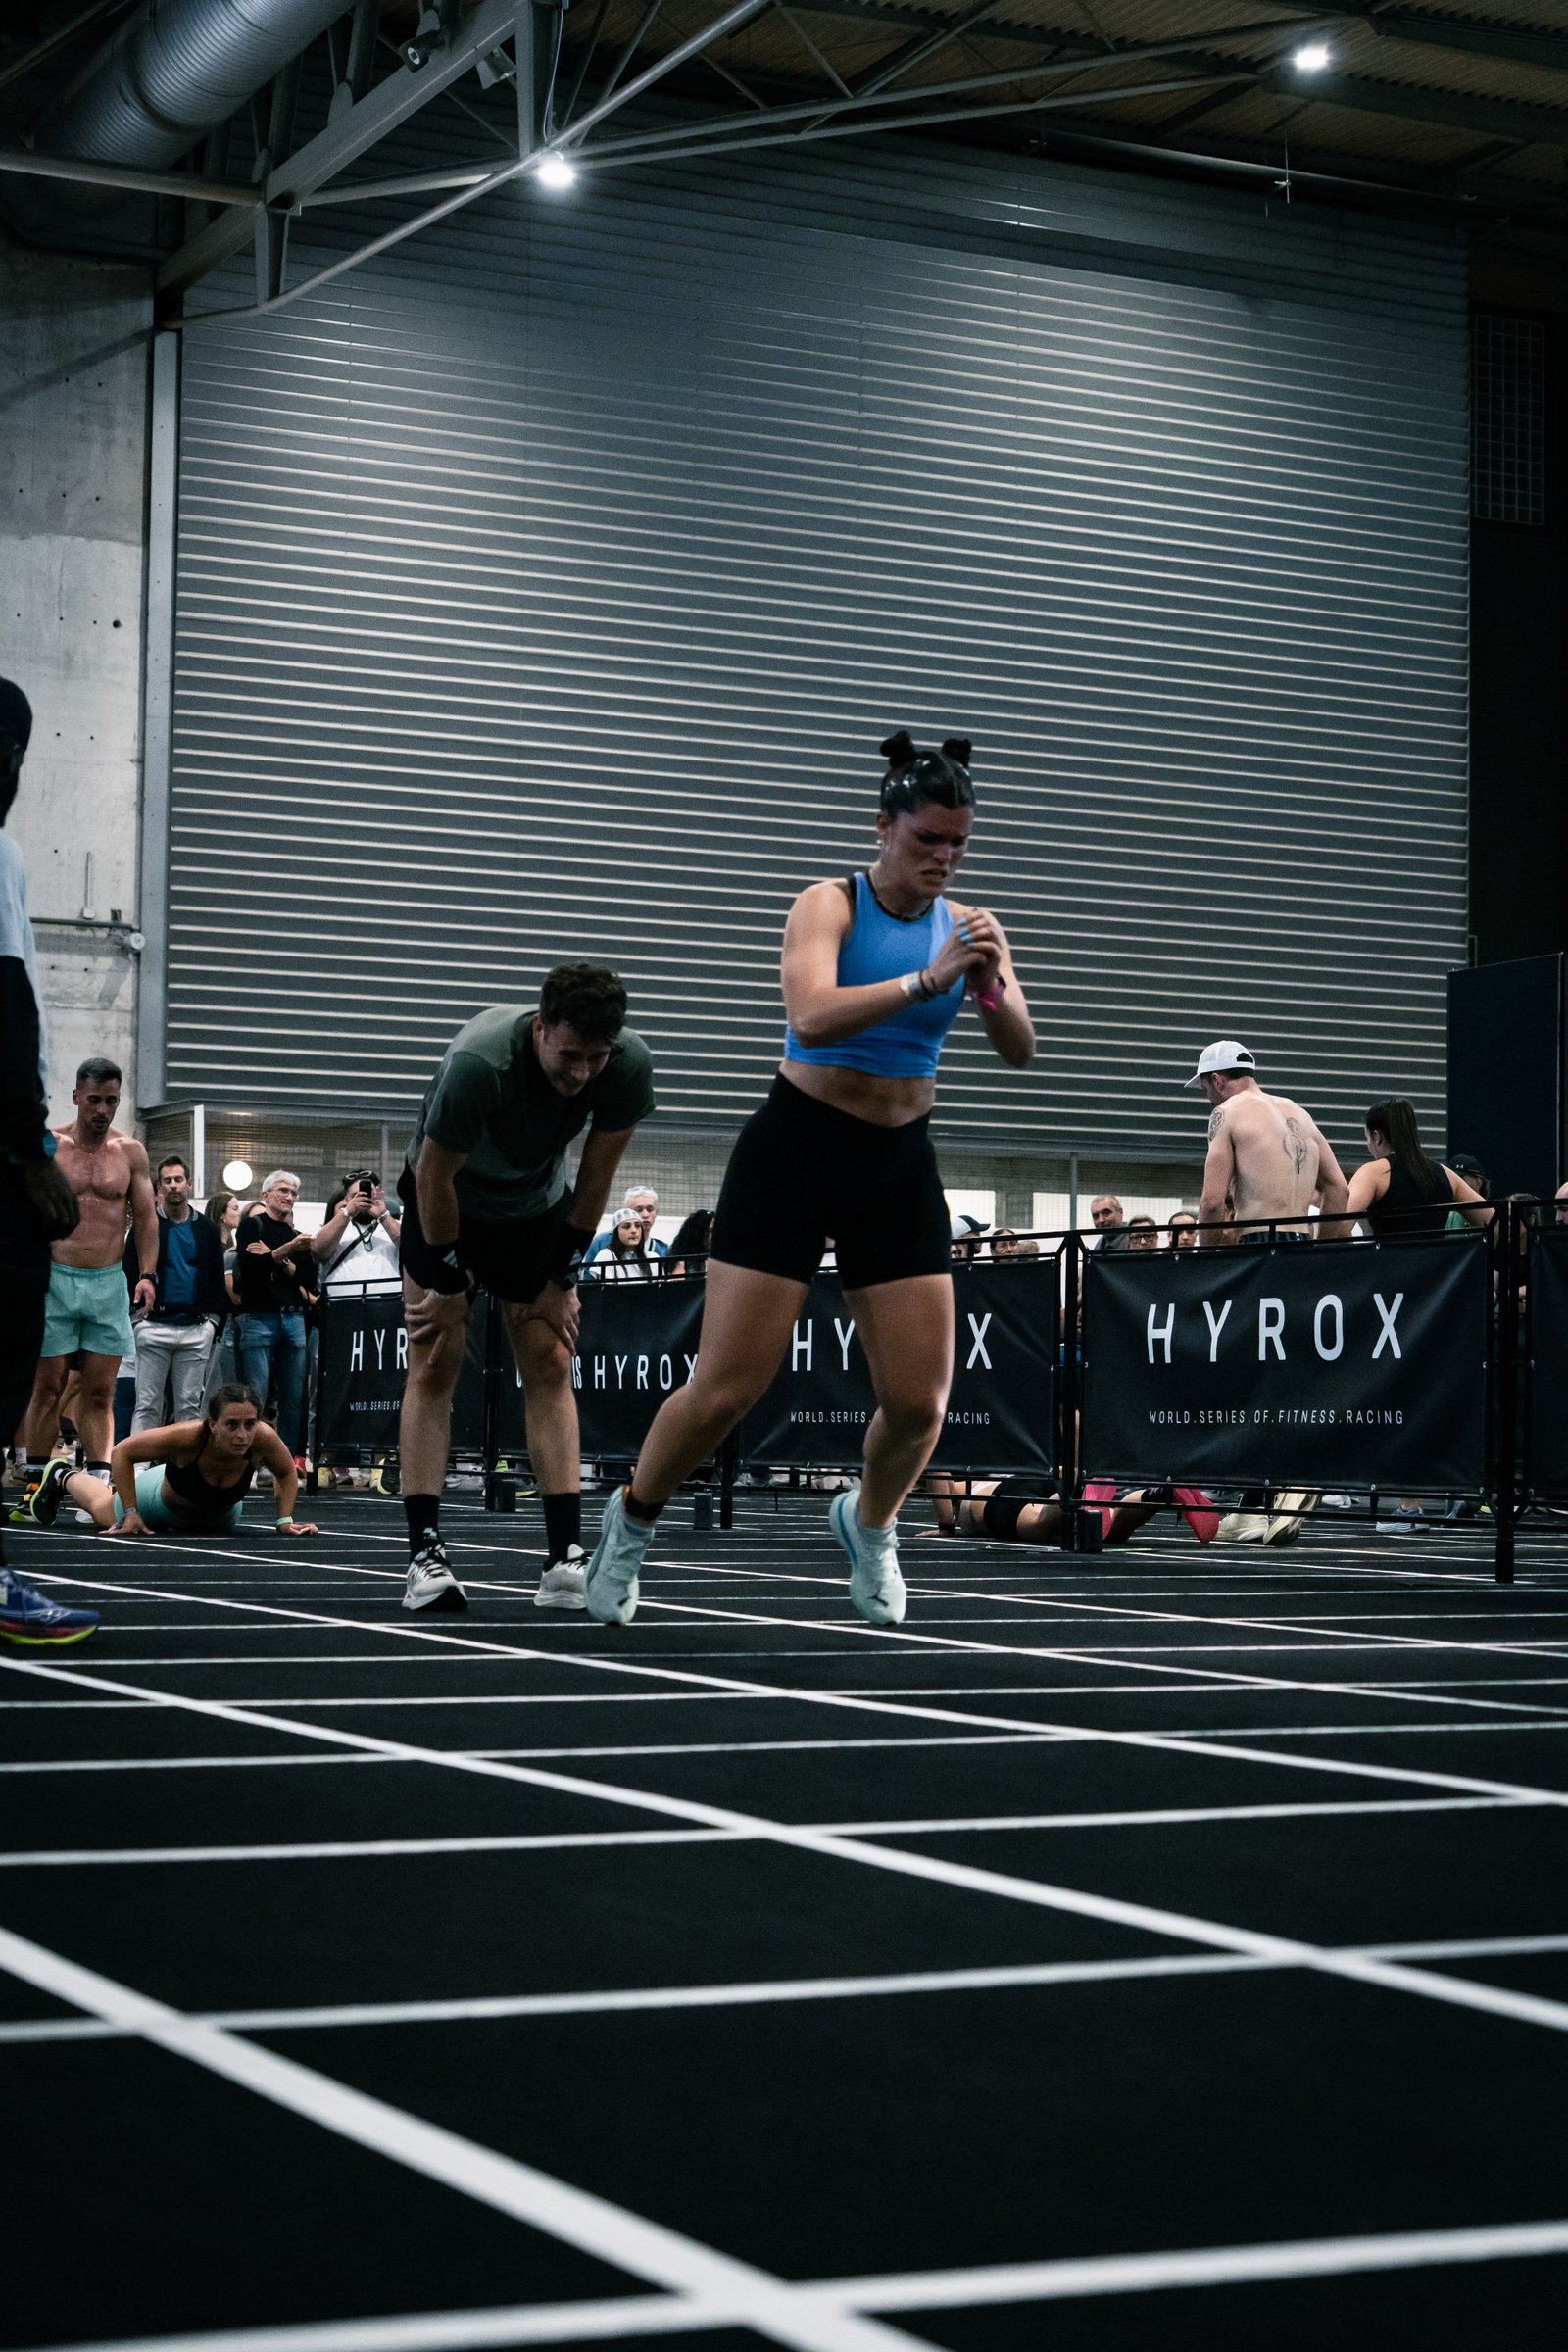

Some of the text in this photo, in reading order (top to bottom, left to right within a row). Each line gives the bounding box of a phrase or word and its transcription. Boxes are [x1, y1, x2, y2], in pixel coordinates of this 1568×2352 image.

[791, 1312, 993, 1372] HYX
[1146, 1293, 1404, 1364] HYROX
[594, 1353, 698, 1391] HYROX
